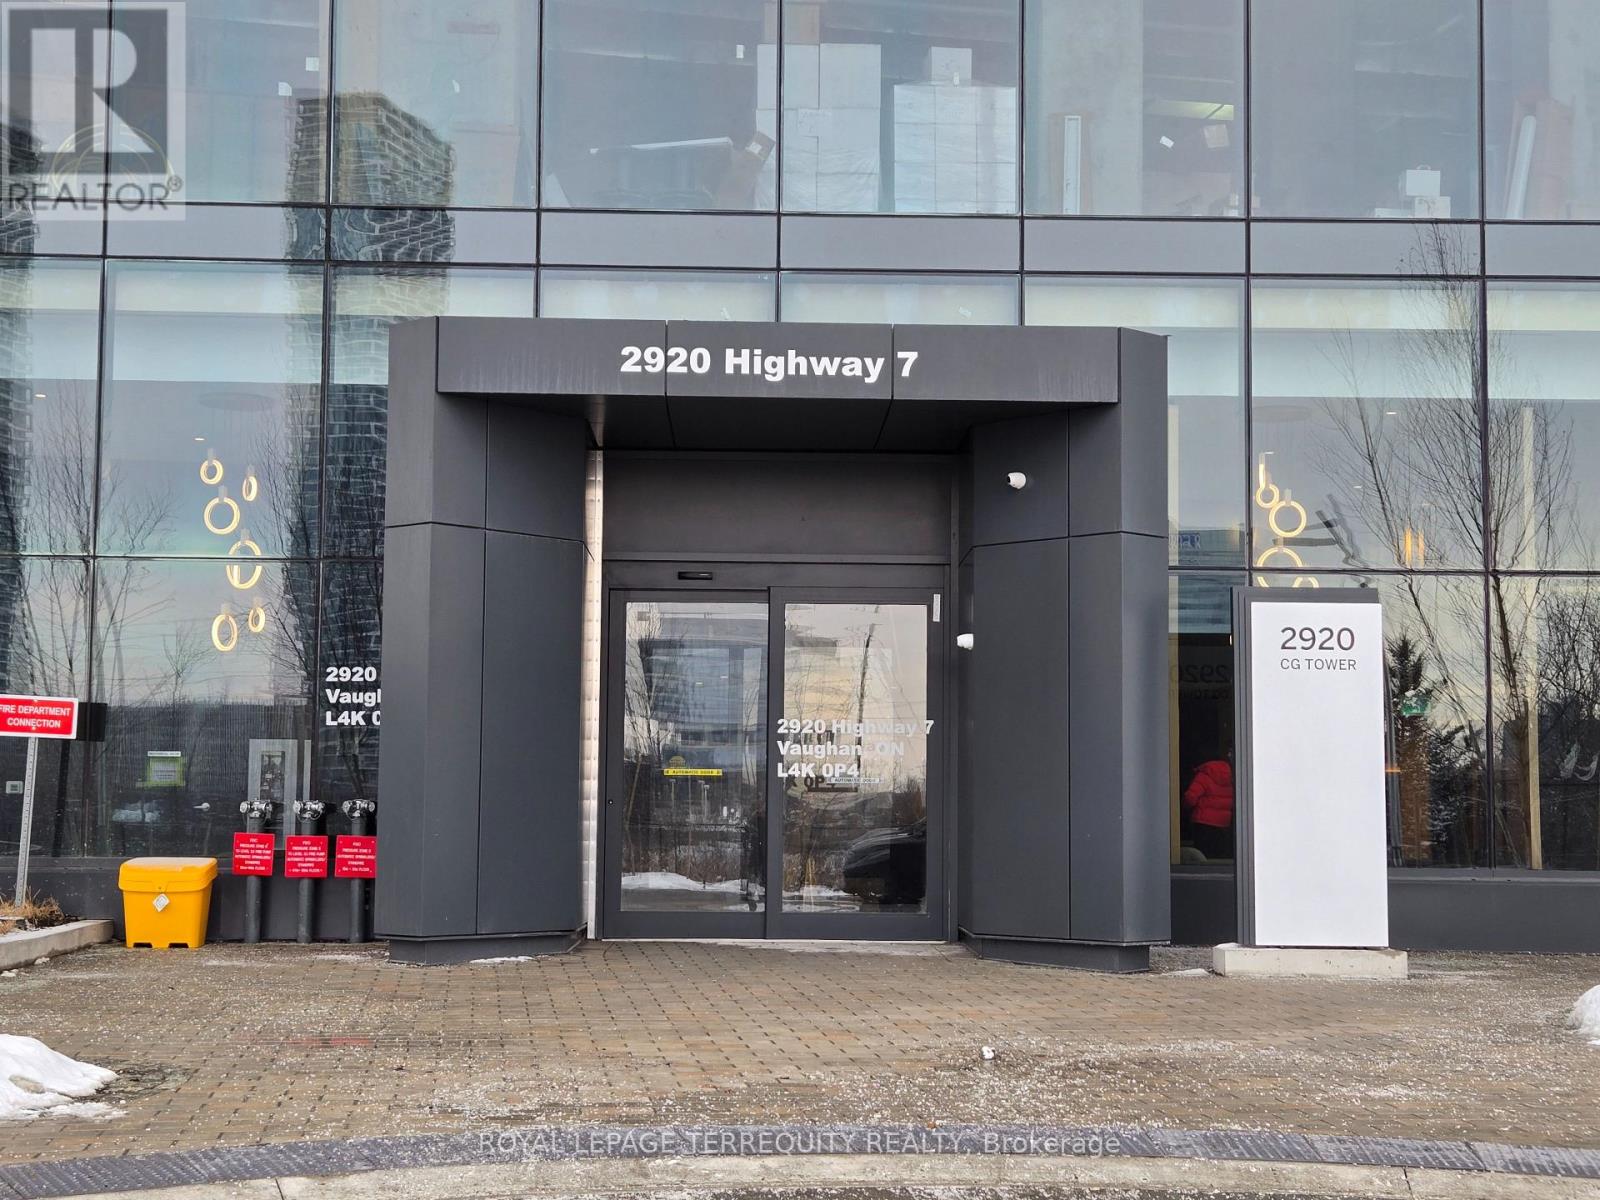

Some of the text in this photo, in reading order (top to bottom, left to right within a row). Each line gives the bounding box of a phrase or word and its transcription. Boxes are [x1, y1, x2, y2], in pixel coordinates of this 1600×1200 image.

[620, 346, 919, 384] 2920 Highway 7
[1280, 627, 1355, 651] 2920
[1280, 658, 1357, 671] CG TOWER
[325, 666, 377, 682] 2920
[18, 705, 71, 716] DEPARTMENT
[325, 710, 366, 726] L4K
[7, 717, 61, 728] CONNECTION
[777, 719, 934, 737] 2920 Highway 7
[876, 741, 905, 756] ON
[777, 762, 860, 778] L4K 0P4
